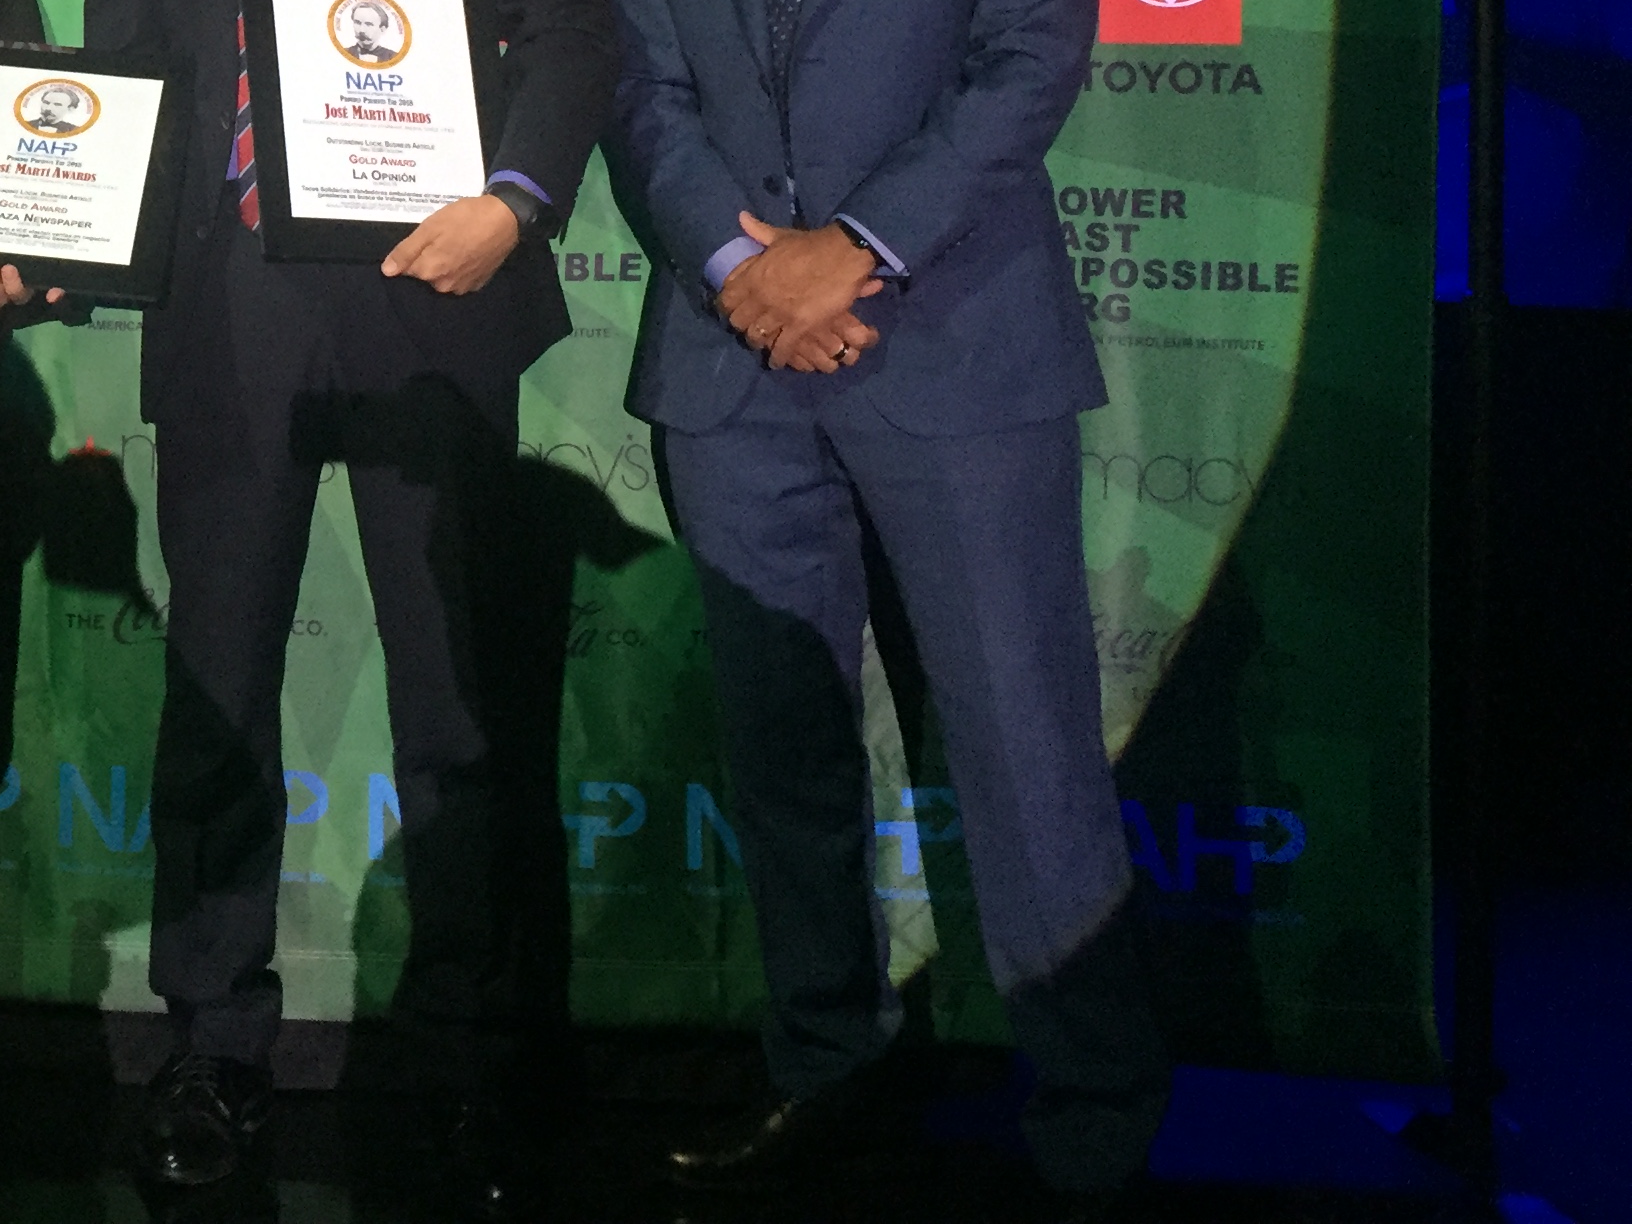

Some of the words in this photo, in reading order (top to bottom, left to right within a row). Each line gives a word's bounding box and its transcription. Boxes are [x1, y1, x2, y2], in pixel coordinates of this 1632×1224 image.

[345, 71, 403, 92] NAHP
[1083, 60, 1262, 95] TOYOTA
[388, 107, 431, 124] AWARDS
[17, 137, 78, 156] NAHP
[52, 167, 97, 182] AWARDS
[1058, 186, 1187, 219] OWER
[24, 213, 93, 229] NEWSPAPER
[1061, 221, 1140, 253] AST
[1070, 256, 1300, 294] POSSIBLE
[1079, 293, 1131, 324] RG
[67, 613, 106, 629] THE
[1119, 799, 1307, 895] AHP
